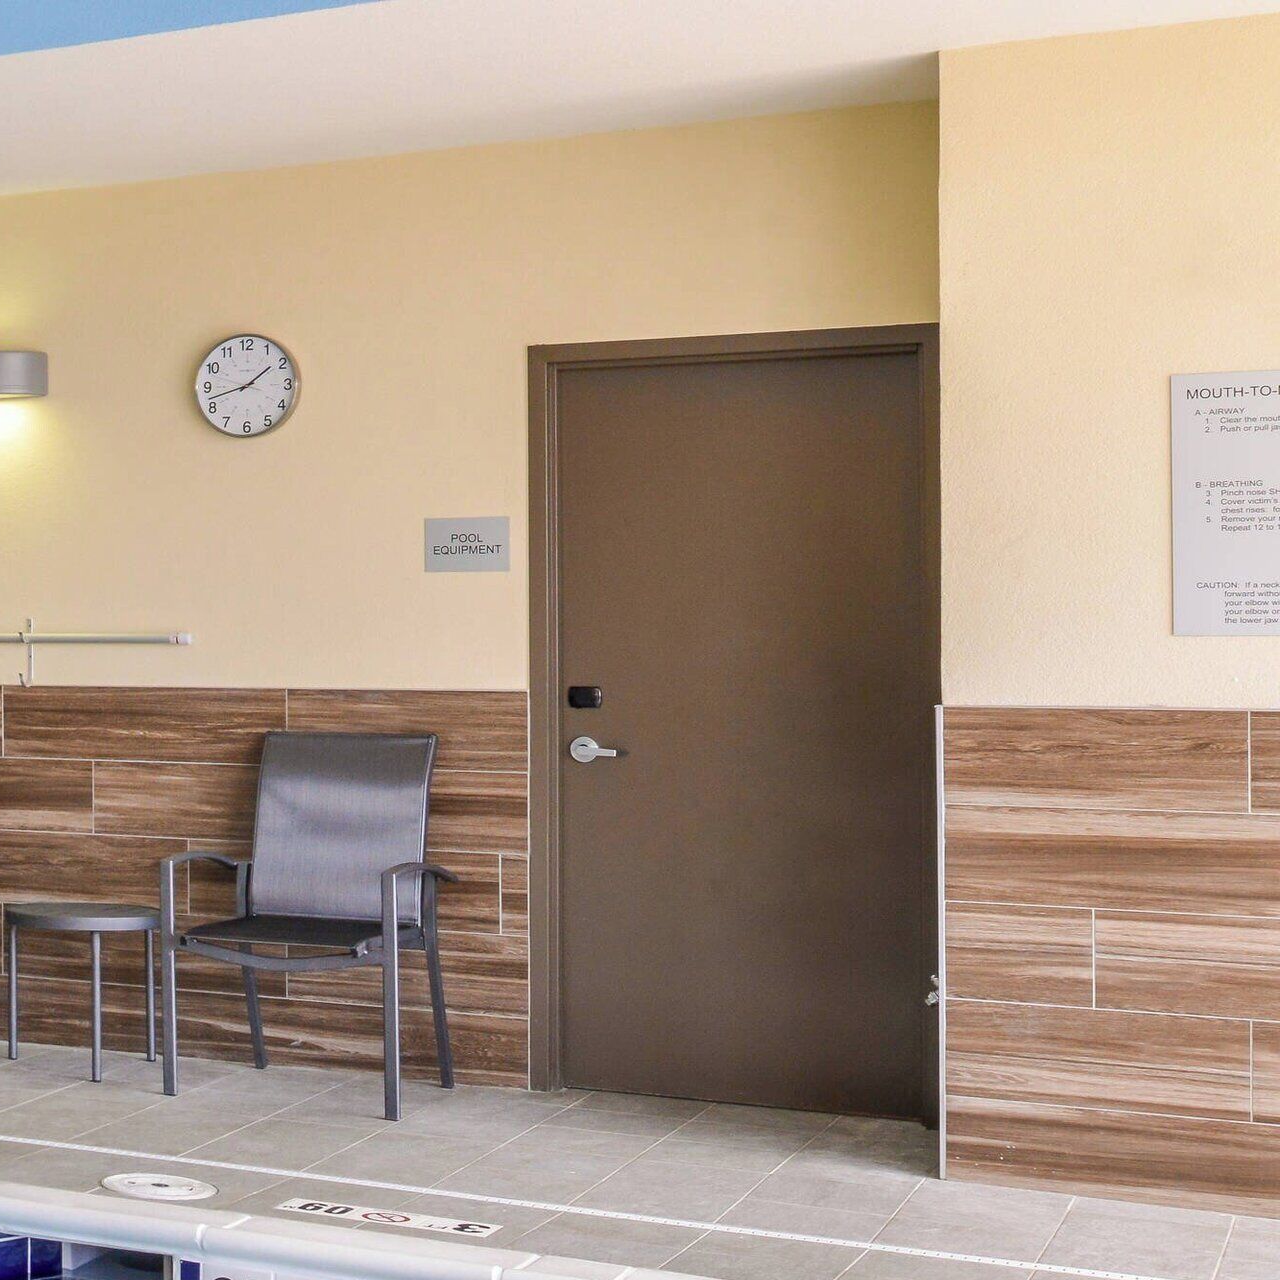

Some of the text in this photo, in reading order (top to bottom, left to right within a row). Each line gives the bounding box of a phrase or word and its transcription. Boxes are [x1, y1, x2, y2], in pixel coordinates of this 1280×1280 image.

[240, 338, 254, 351] 12
[263, 343, 270, 355] 1
[221, 346, 232, 358] 11
[206, 361, 220, 374] 10
[278, 357, 287, 370] 2
[203, 381, 212, 393] 9
[283, 378, 292, 391] 3
[1186, 385, 1280, 400] MOUTH-TO-
[208, 401, 217, 414] 8
[277, 399, 286, 410] 4
[1209, 407, 1245, 415] AIRWAY
[222, 416, 231, 428] 7
[263, 415, 272, 427] 5
[1220, 416, 1242, 424] Clear
[242, 421, 251, 433] 6
[1209, 480, 1263, 488] BREATHING
[1221, 524, 1251, 532] Repeat
[450, 533, 484, 543] POOL
[433, 544, 502, 555] EQUIPMENT
[1196, 581, 1240, 589] CAUTION:
[1264, 617, 1278, 625] jaw
